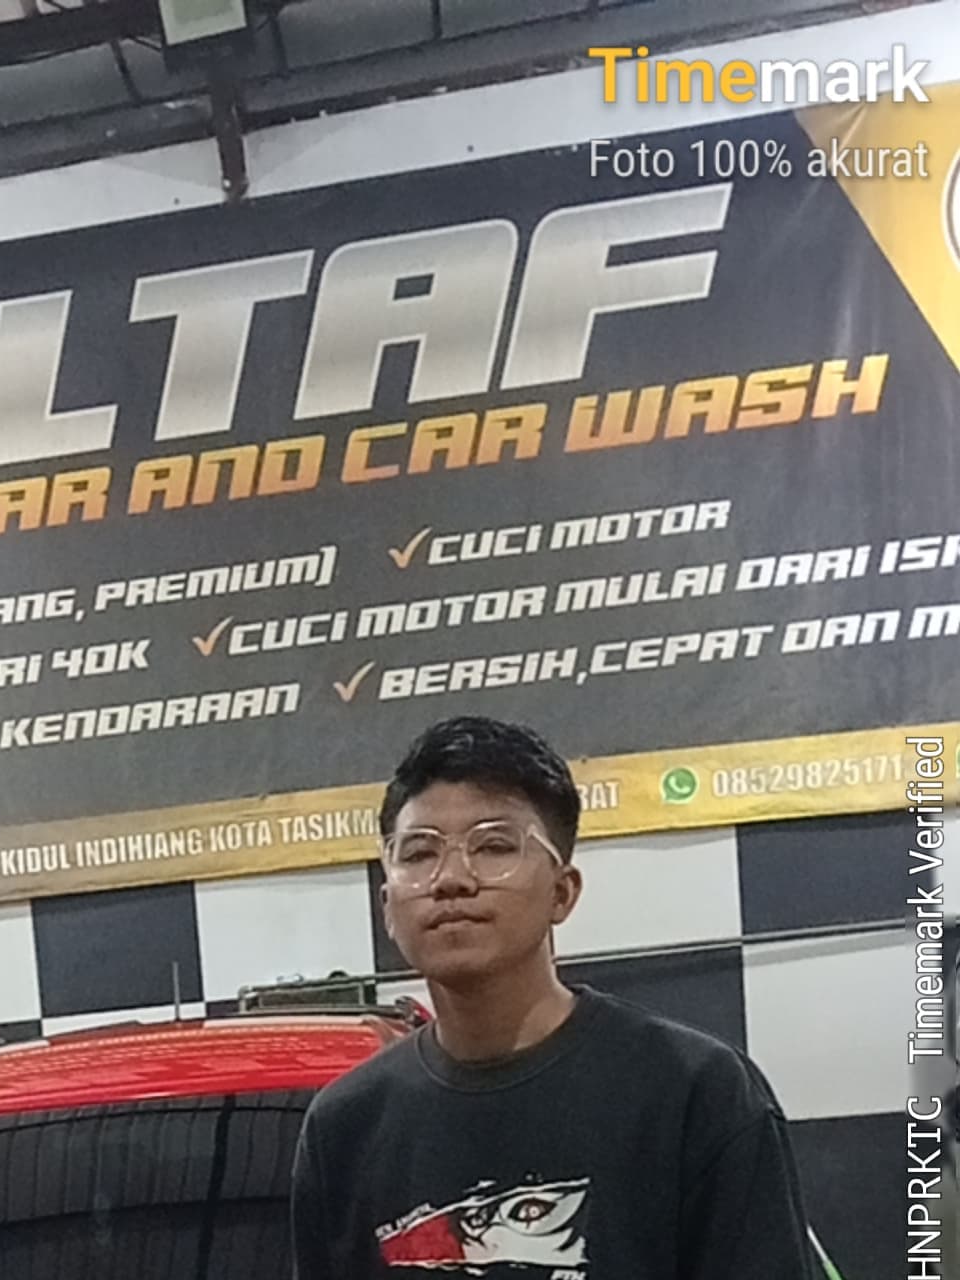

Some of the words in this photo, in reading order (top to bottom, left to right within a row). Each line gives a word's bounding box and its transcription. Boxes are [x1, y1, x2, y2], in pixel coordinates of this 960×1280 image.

[128, 435, 326, 516] AND
[341, 403, 548, 485] CAR
[564, 353, 889, 453] WASH
[428, 525, 542, 565] CUCI
[550, 500, 733, 551] MOTOR
[228, 611, 348, 656] CUCI
[356, 586, 546, 638] MOTOR
[554, 563, 727, 614] MULAI
[736, 545, 872, 591] DARI
[781, 609, 901, 655] DAN
[51, 639, 152, 679] 40K
[0, 683, 300, 749] KENDARAAN
[1, 841, 70, 875] KIDUL
[76, 827, 204, 867] INDIHIANG
[210, 818, 273, 853] KOTA
